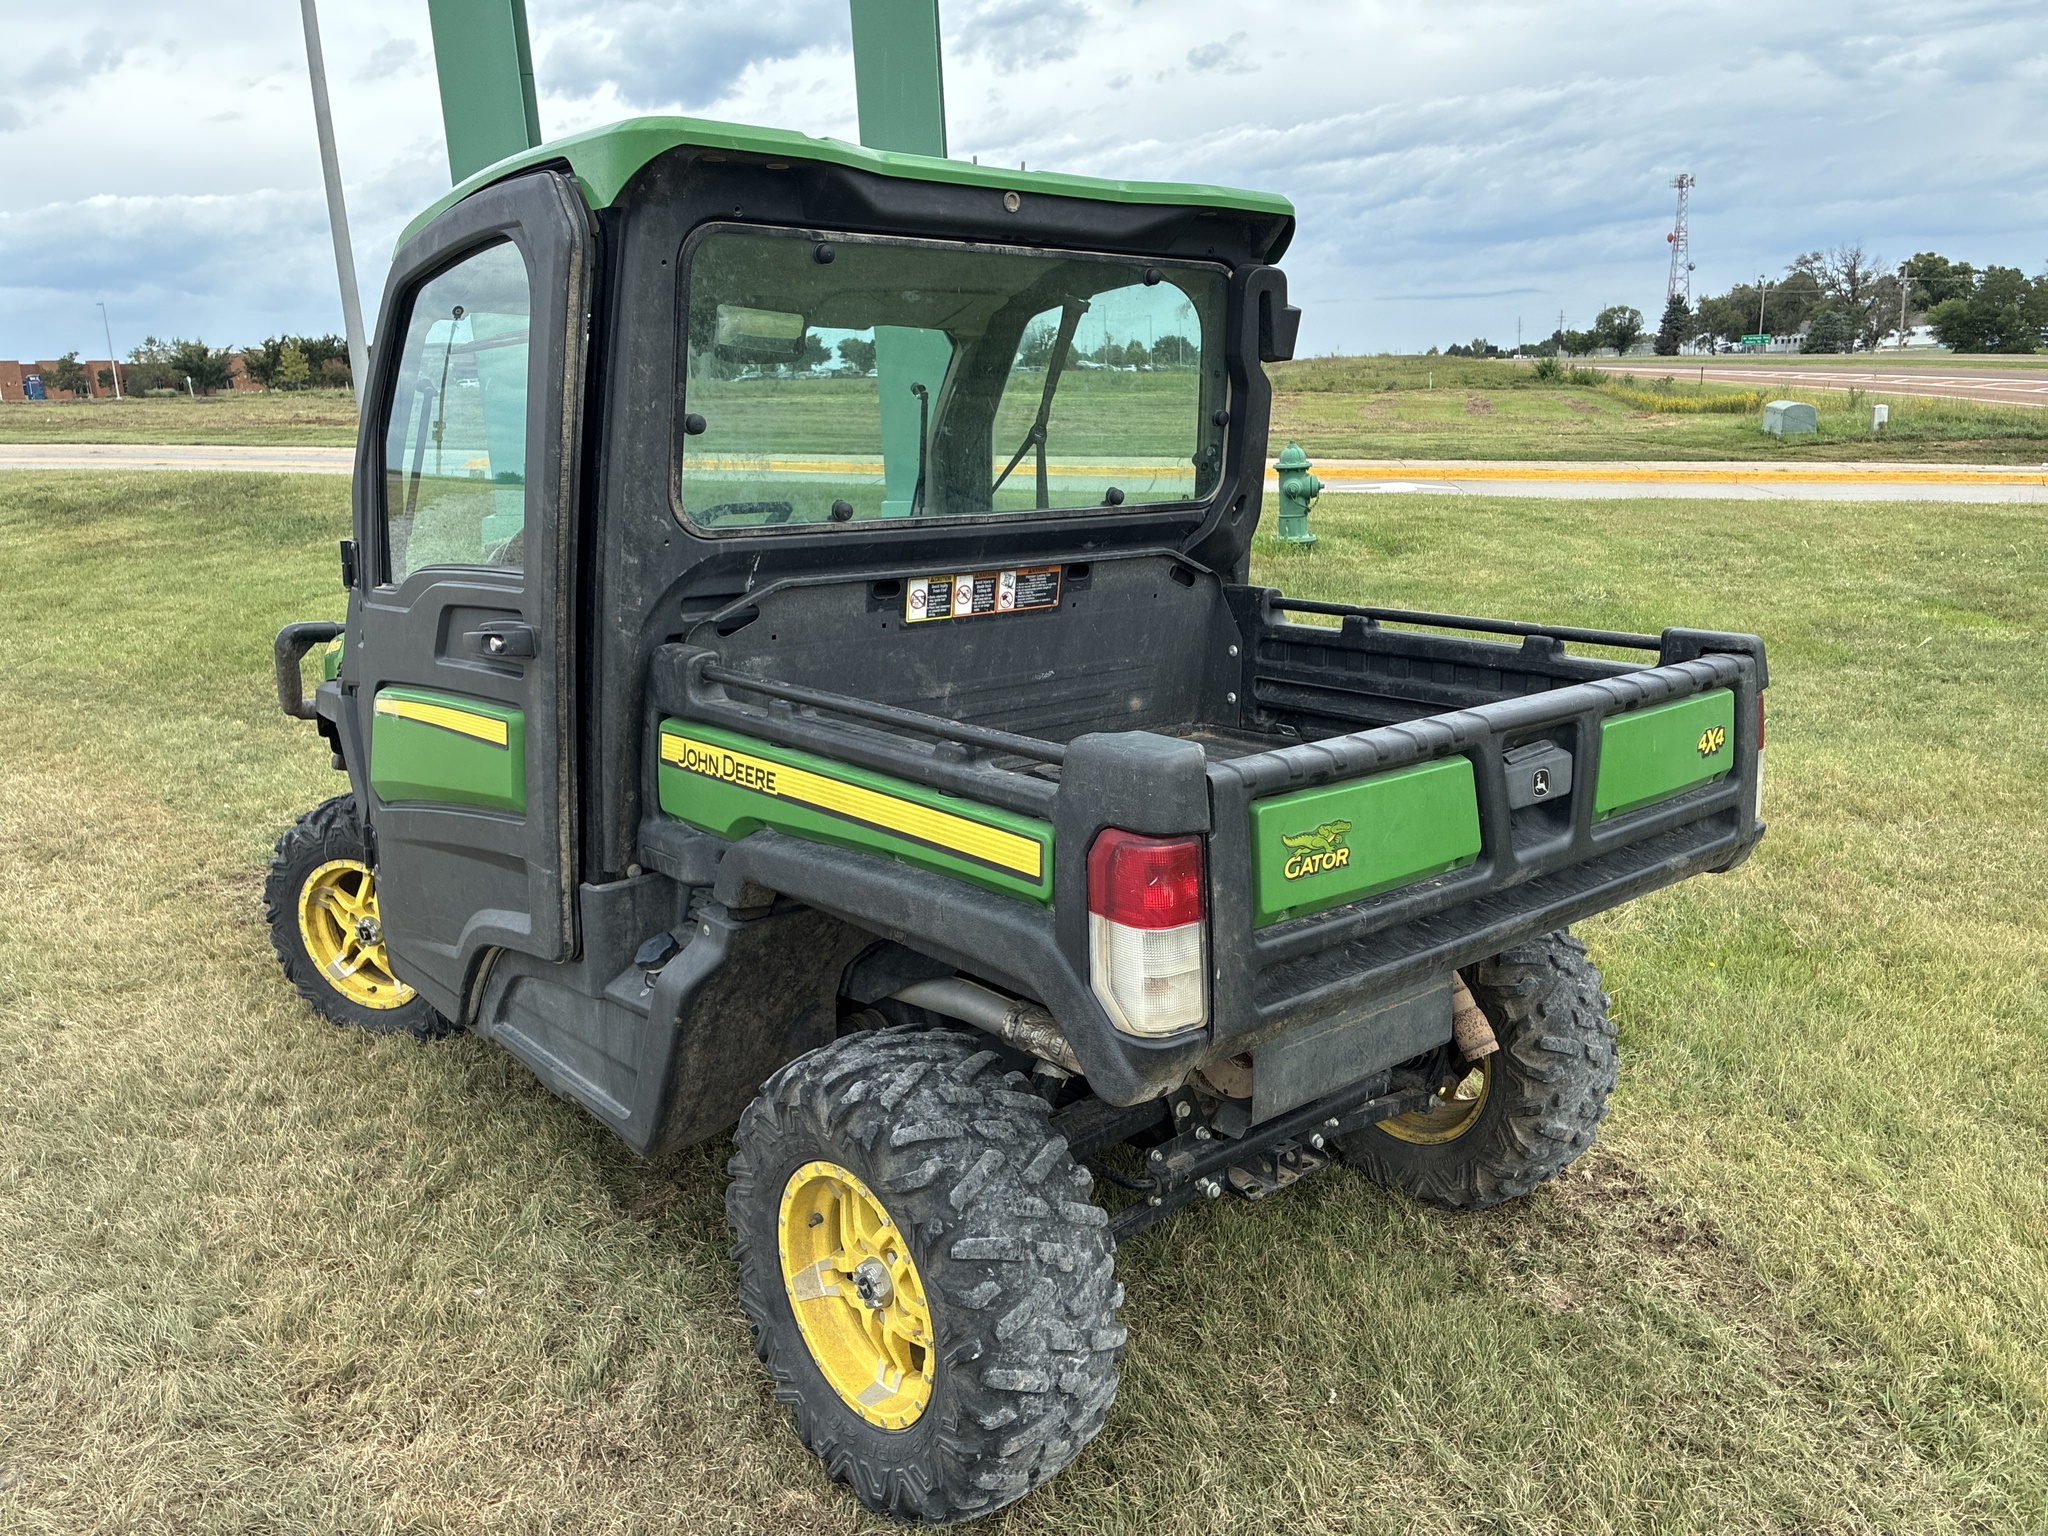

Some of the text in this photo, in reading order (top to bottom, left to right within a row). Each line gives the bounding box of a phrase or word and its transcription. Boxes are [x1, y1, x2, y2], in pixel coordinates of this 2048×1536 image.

[1696, 726, 1725, 757] 4X4
[678, 742, 777, 792] JOHN DEERE
[1284, 847, 1350, 880] GATOR
